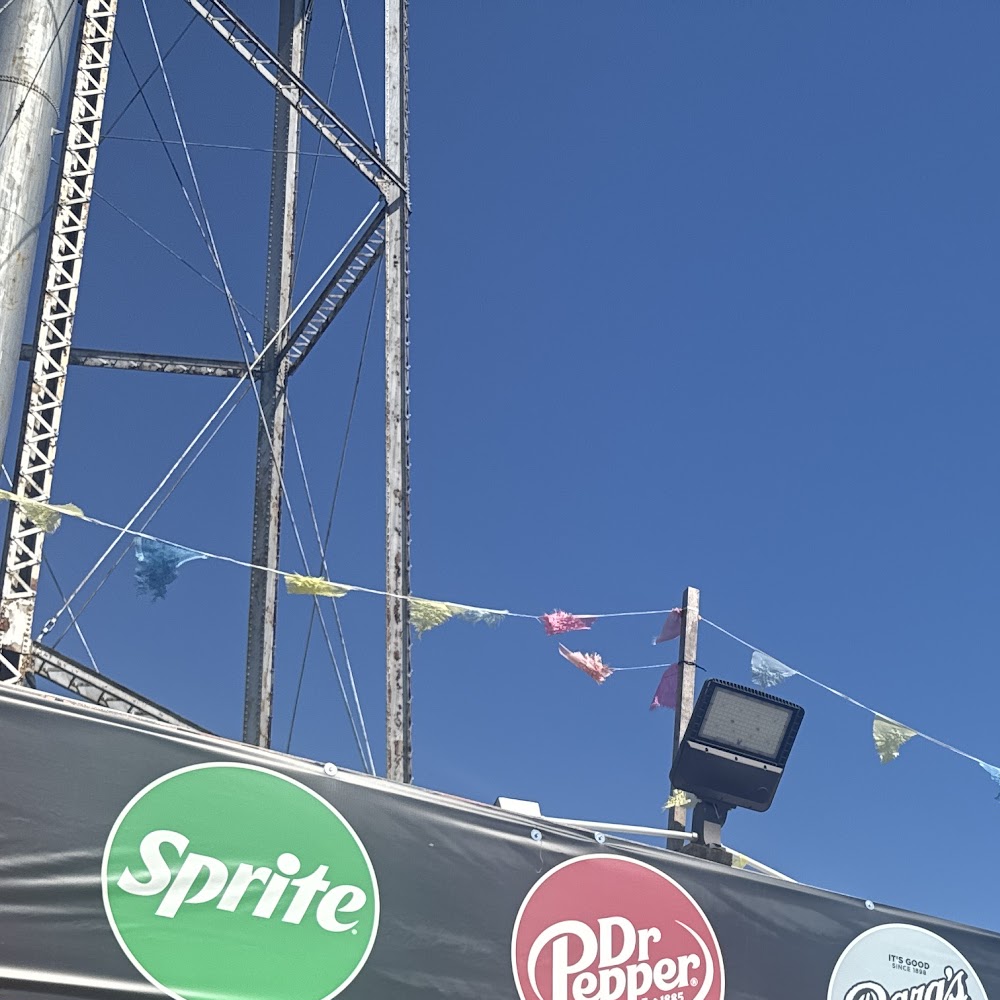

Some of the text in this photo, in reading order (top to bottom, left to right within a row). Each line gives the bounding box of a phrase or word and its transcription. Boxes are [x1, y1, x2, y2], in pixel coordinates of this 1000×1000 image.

[117, 830, 367, 934] Sprite
[597, 916, 661, 968] Dr
[888, 953, 930, 970] IT'S GOOD
[891, 962, 911, 972] SINCE
